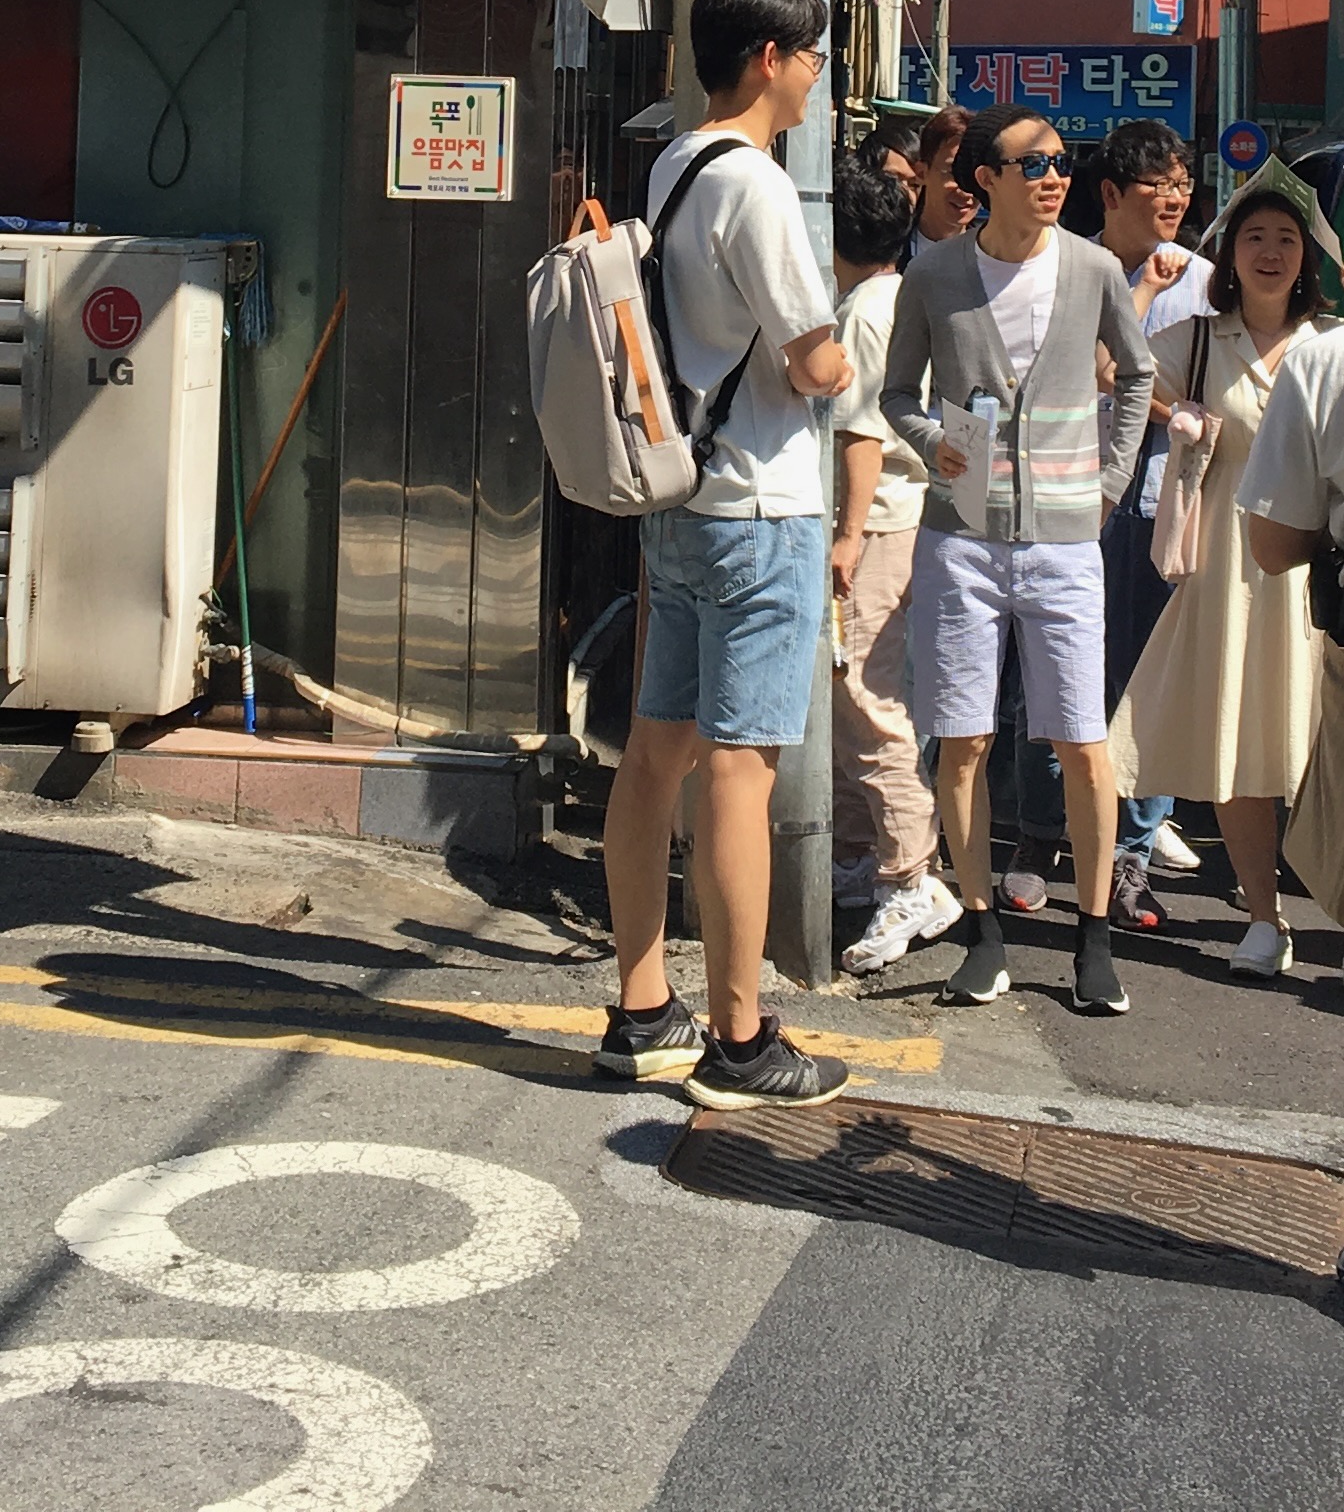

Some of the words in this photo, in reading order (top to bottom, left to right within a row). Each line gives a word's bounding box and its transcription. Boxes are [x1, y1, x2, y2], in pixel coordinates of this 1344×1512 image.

[969, 52, 1069, 108] 세탁
[1079, 53, 1179, 108] 타운
[429, 101, 461, 134] 목포
[411, 137, 485, 171] 으뜸맛집
[87, 356, 134, 386] LG
